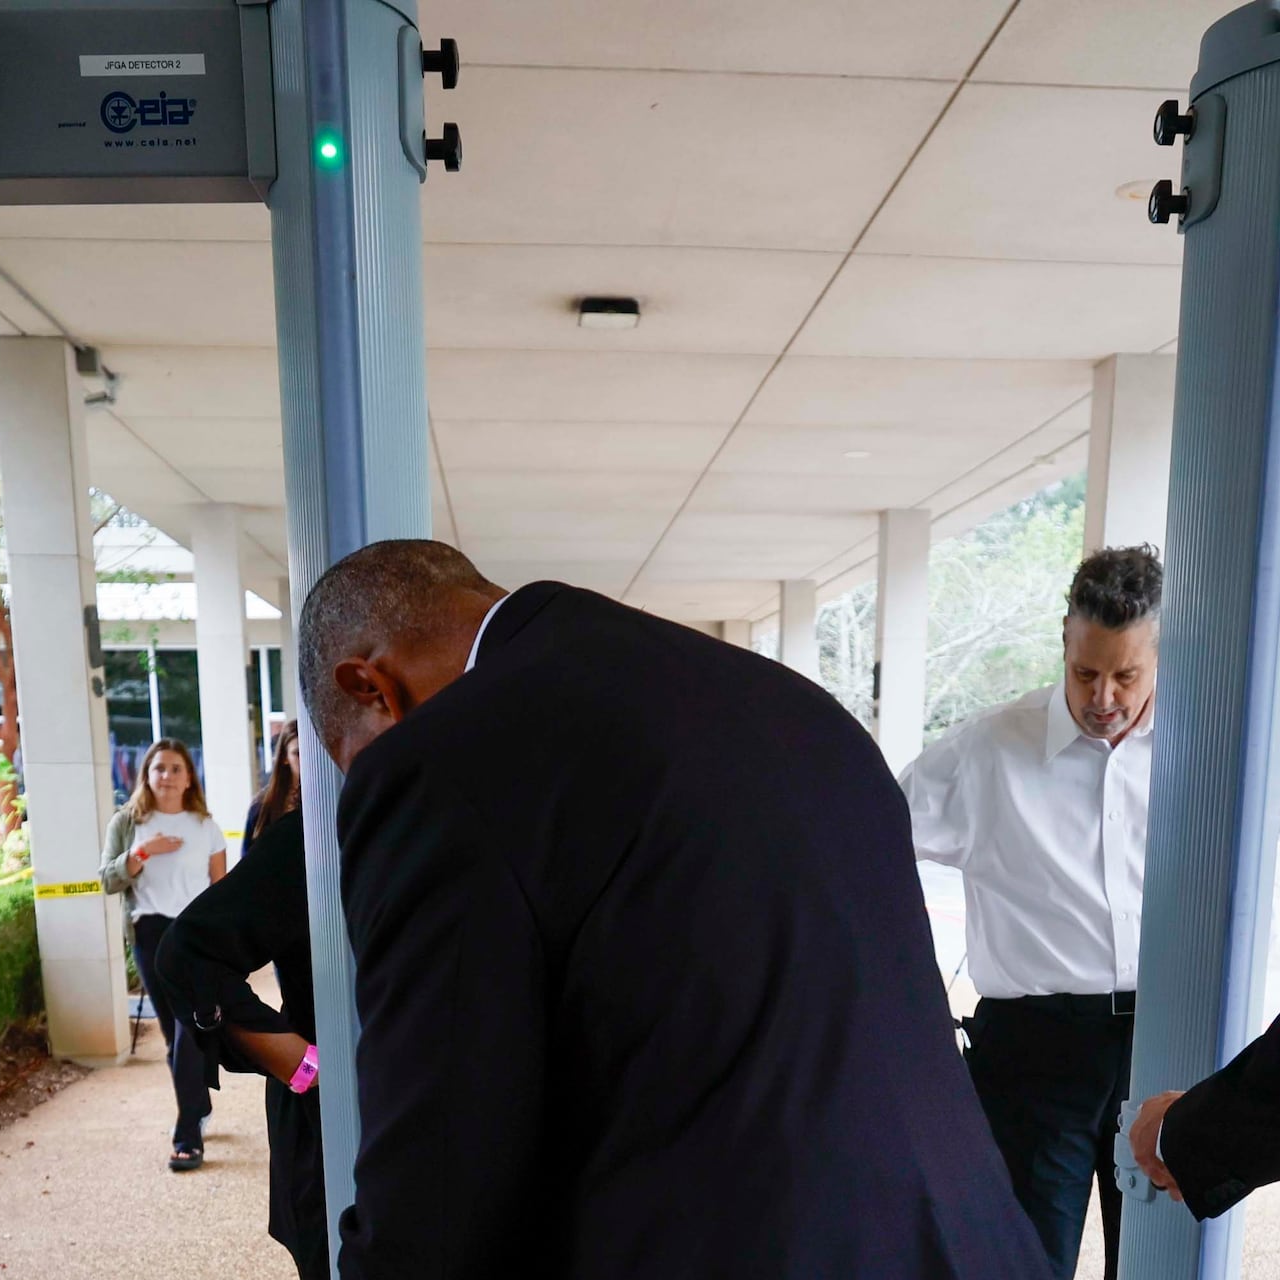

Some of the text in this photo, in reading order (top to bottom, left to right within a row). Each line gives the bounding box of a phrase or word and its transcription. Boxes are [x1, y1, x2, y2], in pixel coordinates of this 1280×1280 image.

[104, 60, 182, 70] JFGA DETECTOR 2
[104, 136, 197, 148] www.ceia.net
